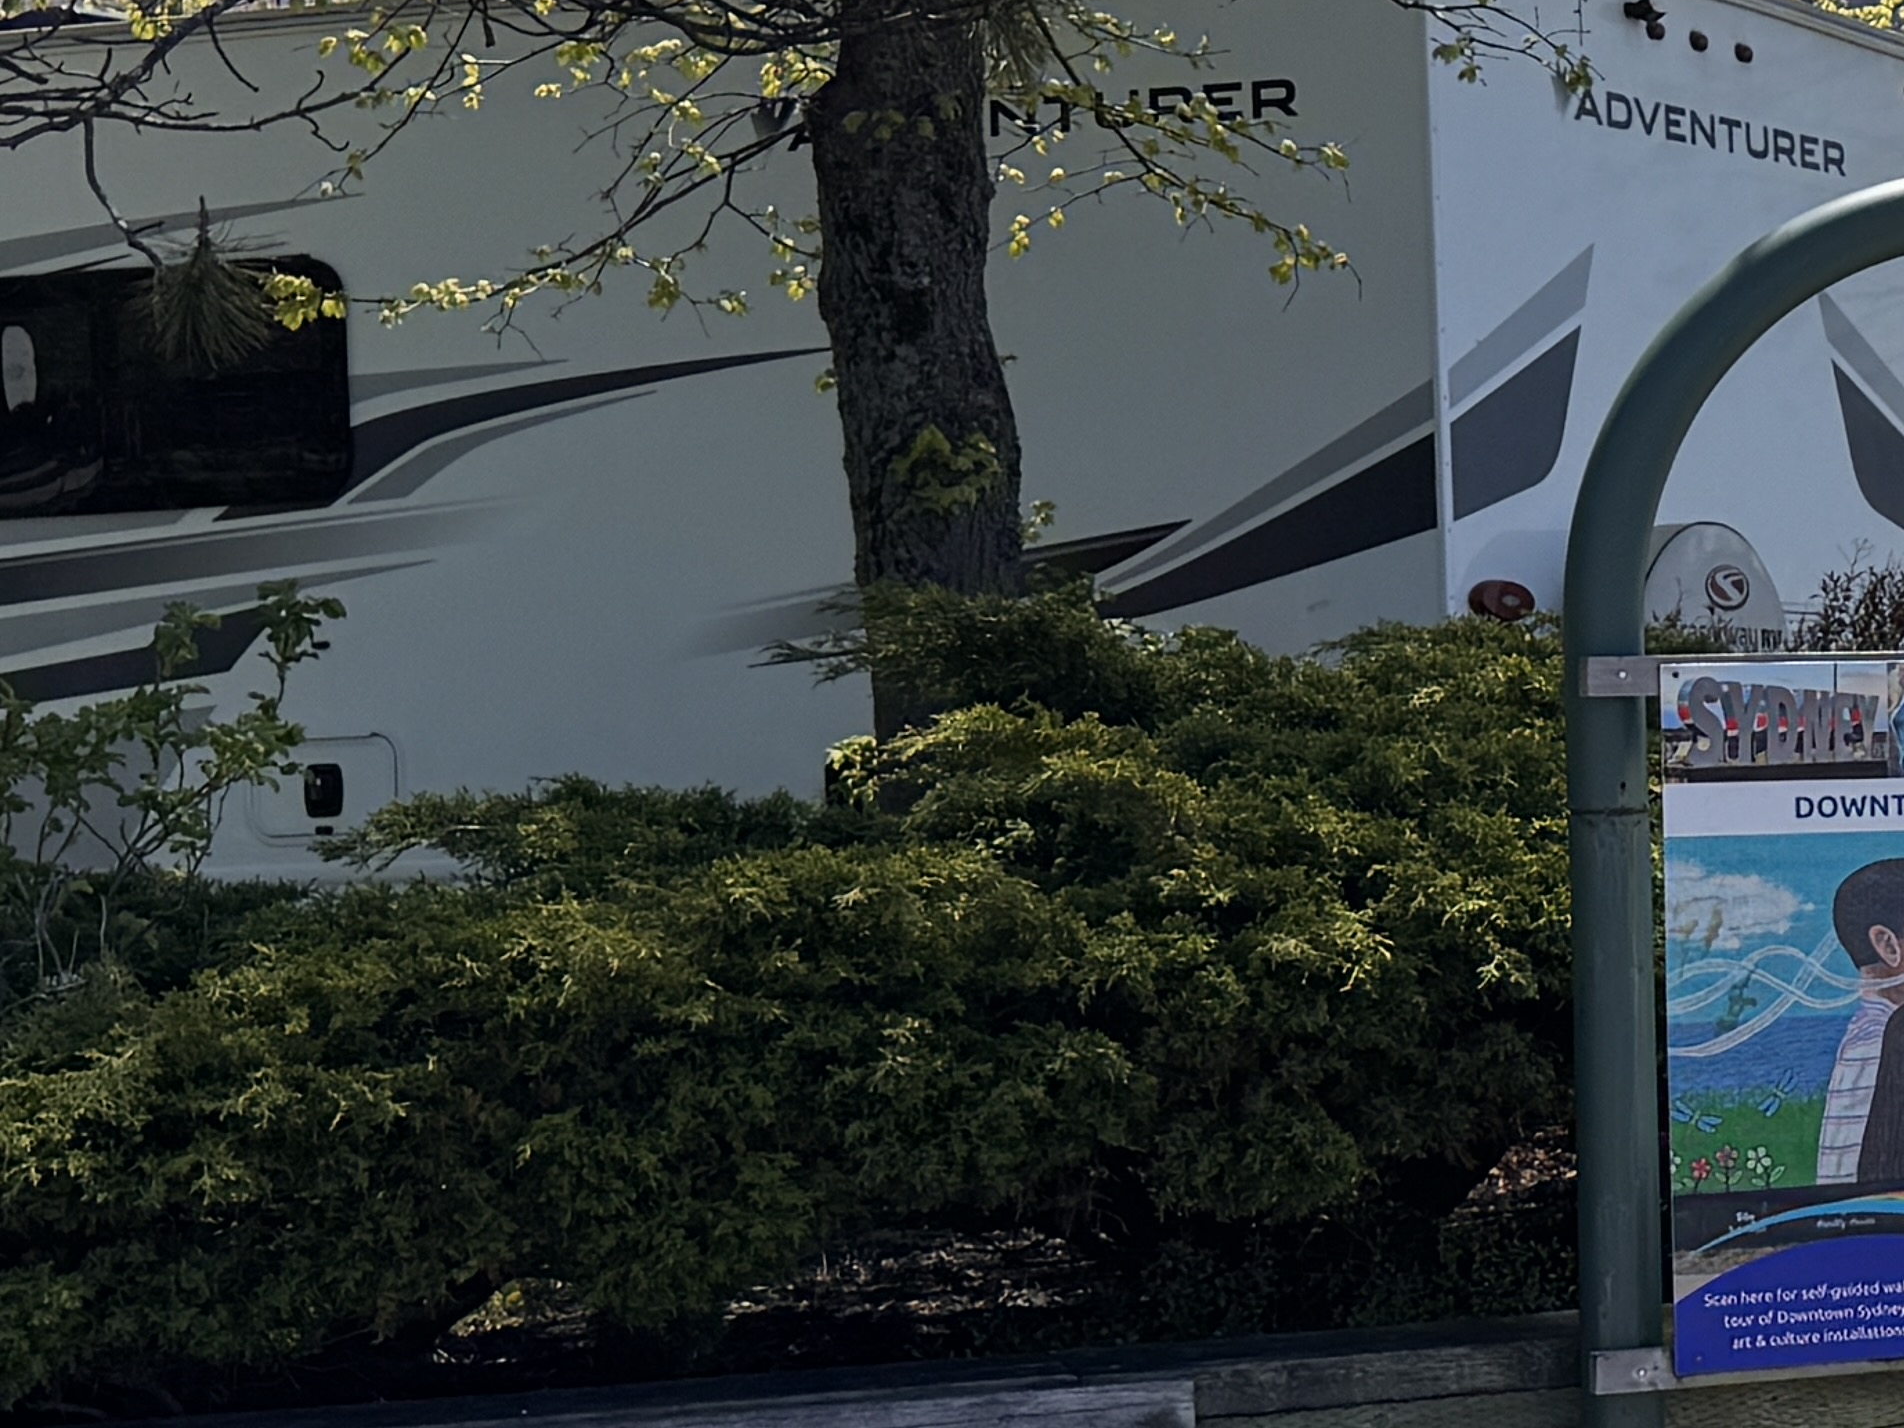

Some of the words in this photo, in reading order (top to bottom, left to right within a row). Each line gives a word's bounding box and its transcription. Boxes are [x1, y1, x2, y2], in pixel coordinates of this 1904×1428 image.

[1574, 90, 1847, 176] ADVENTURER
[1677, 676, 1879, 764] SYDNEY
[1704, 1291, 1738, 1308] Scan
[1740, 1291, 1774, 1304] here
[1777, 1287, 1798, 1303] for
[1802, 1281, 1880, 1301] self-guided
[1724, 1314, 1755, 1329] tour
[1759, 1310, 1774, 1326] of
[1777, 1306, 1854, 1325] Downtown
[1732, 1336, 1751, 1350] art
[1756, 1334, 1767, 1347] &
[1770, 1330, 1820, 1346] culture
